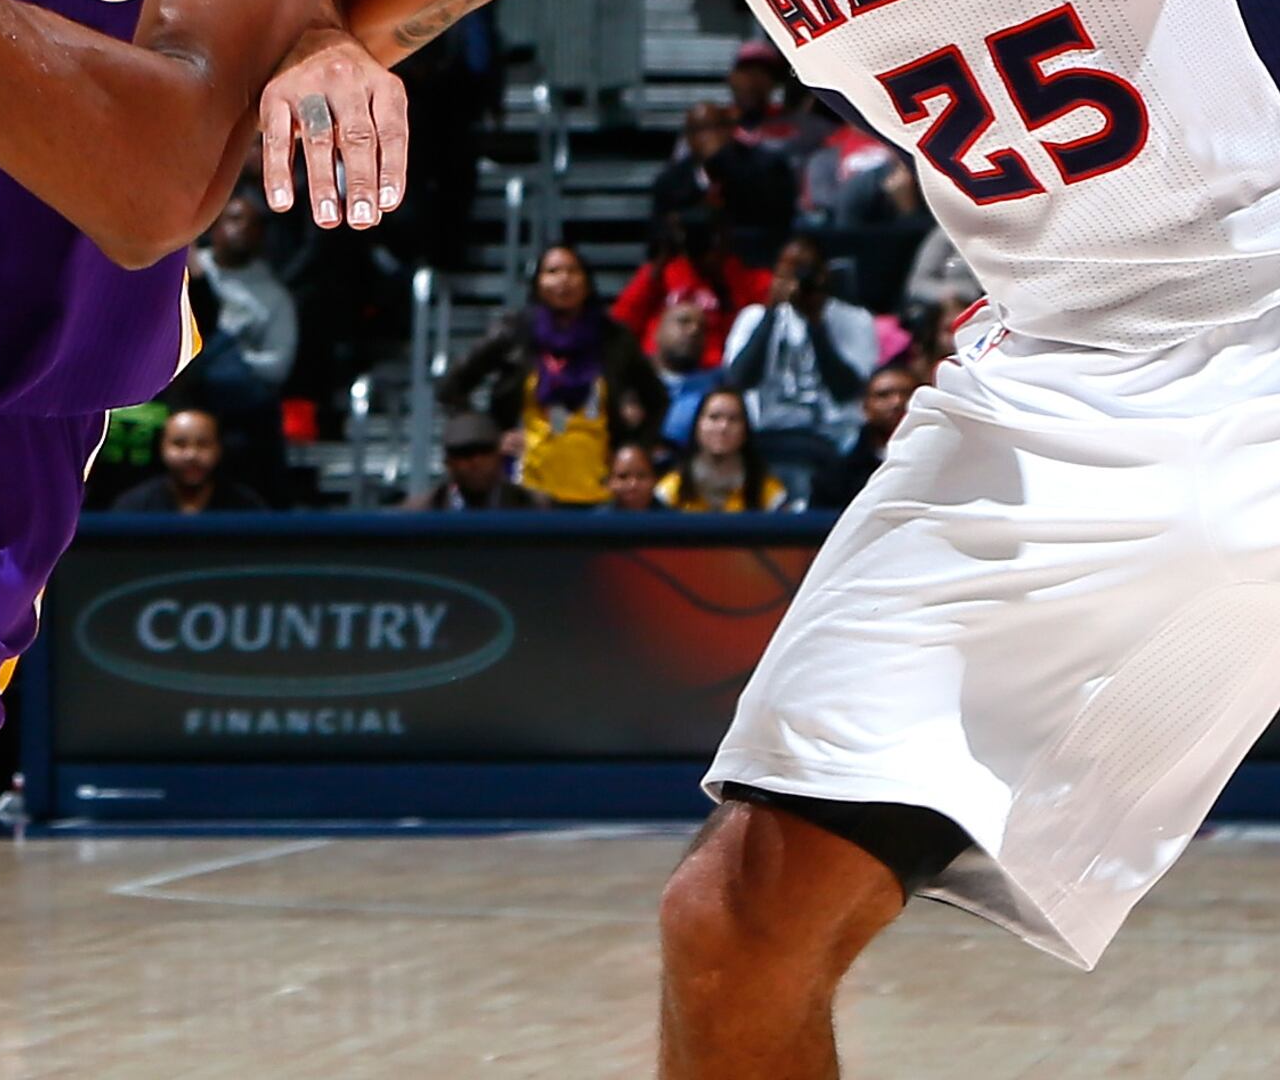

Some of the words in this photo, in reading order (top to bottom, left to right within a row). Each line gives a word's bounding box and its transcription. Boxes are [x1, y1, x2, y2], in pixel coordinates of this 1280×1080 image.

[875, 2, 1150, 206] 25
[137, 600, 448, 652] COUNTRY
[185, 709, 406, 735] FINANCIAL
